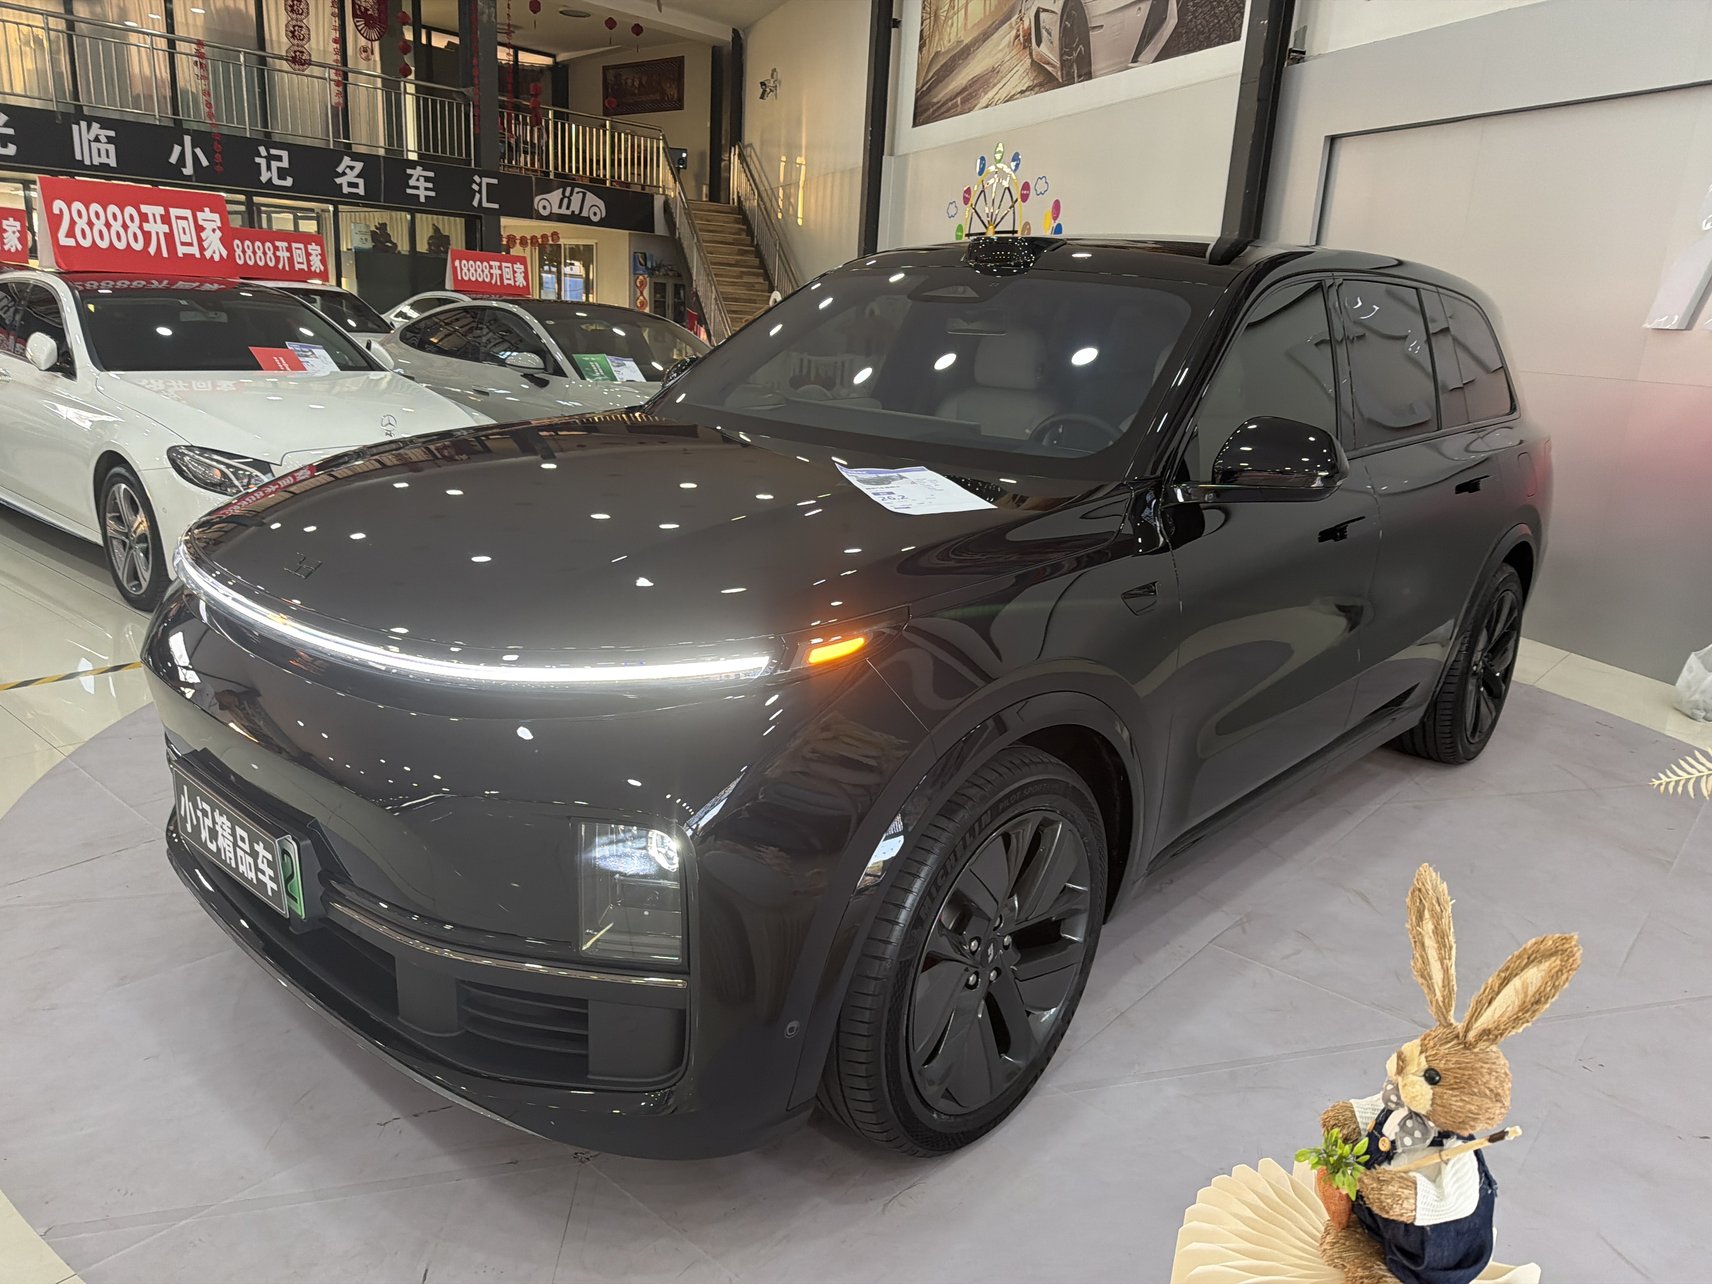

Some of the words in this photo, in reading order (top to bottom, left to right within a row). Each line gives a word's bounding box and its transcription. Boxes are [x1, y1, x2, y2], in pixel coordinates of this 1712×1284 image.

[52, 198, 229, 262] 28888开回家
[454, 258, 527, 288] 18888开回家
[180, 785, 278, 897] 小记精品车
